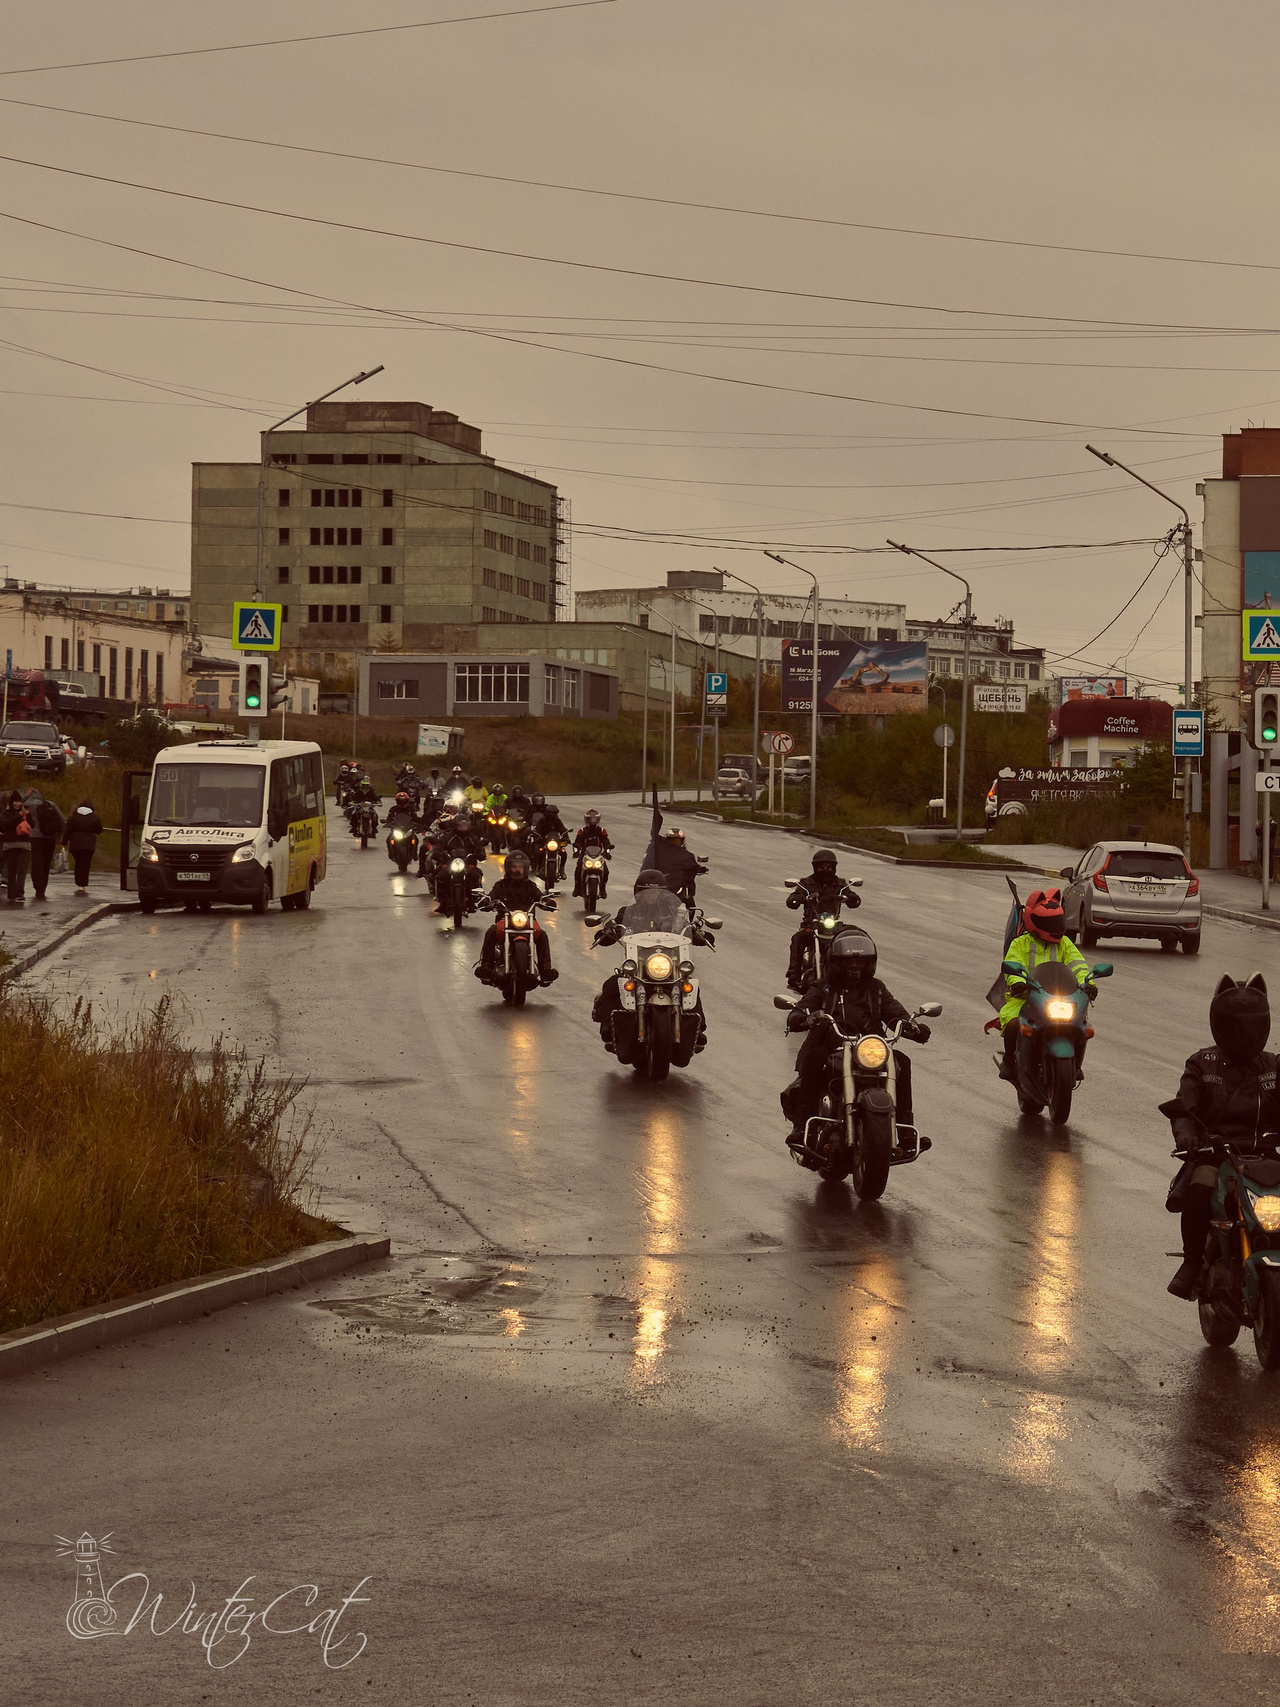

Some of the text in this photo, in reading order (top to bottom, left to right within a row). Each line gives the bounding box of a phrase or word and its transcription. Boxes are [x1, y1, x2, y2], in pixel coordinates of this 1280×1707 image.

[978, 693, 1022, 703] ЩЕБЕНЬ
[788, 700, 814, 710] 9125
[1106, 716, 1136, 725] Coffee
[1103, 724, 1139, 733] Machine
[1018, 768, 1034, 781] за
[175, 828, 245, 838] АвтоЛига
[1204, 1053, 1217, 1061] 49
